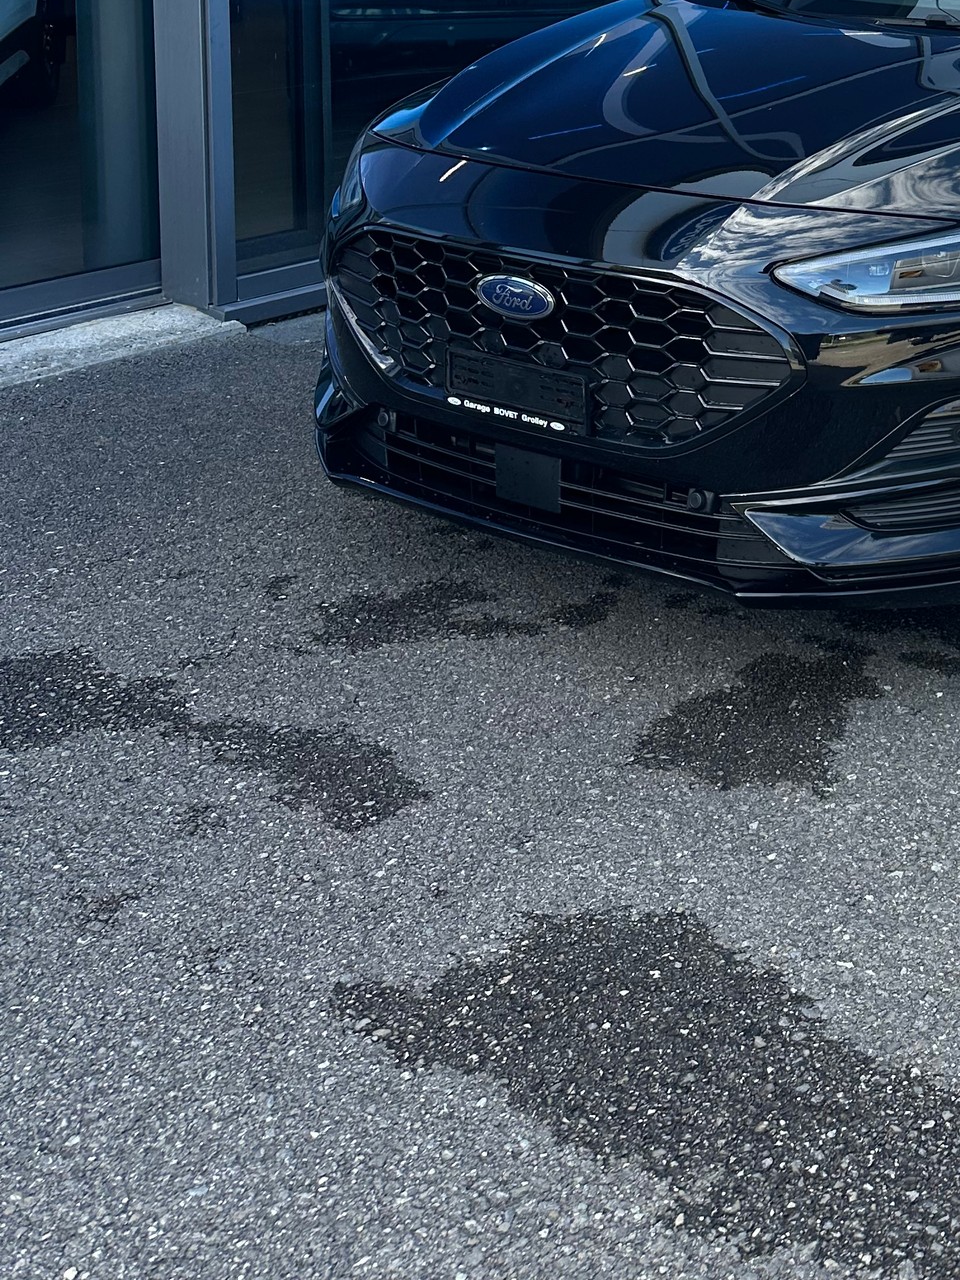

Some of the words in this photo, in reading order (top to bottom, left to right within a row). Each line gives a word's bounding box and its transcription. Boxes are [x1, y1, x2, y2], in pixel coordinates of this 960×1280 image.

[492, 283, 534, 311] Ford
[463, 399, 491, 413] Garage
[493, 406, 519, 420] BOVET
